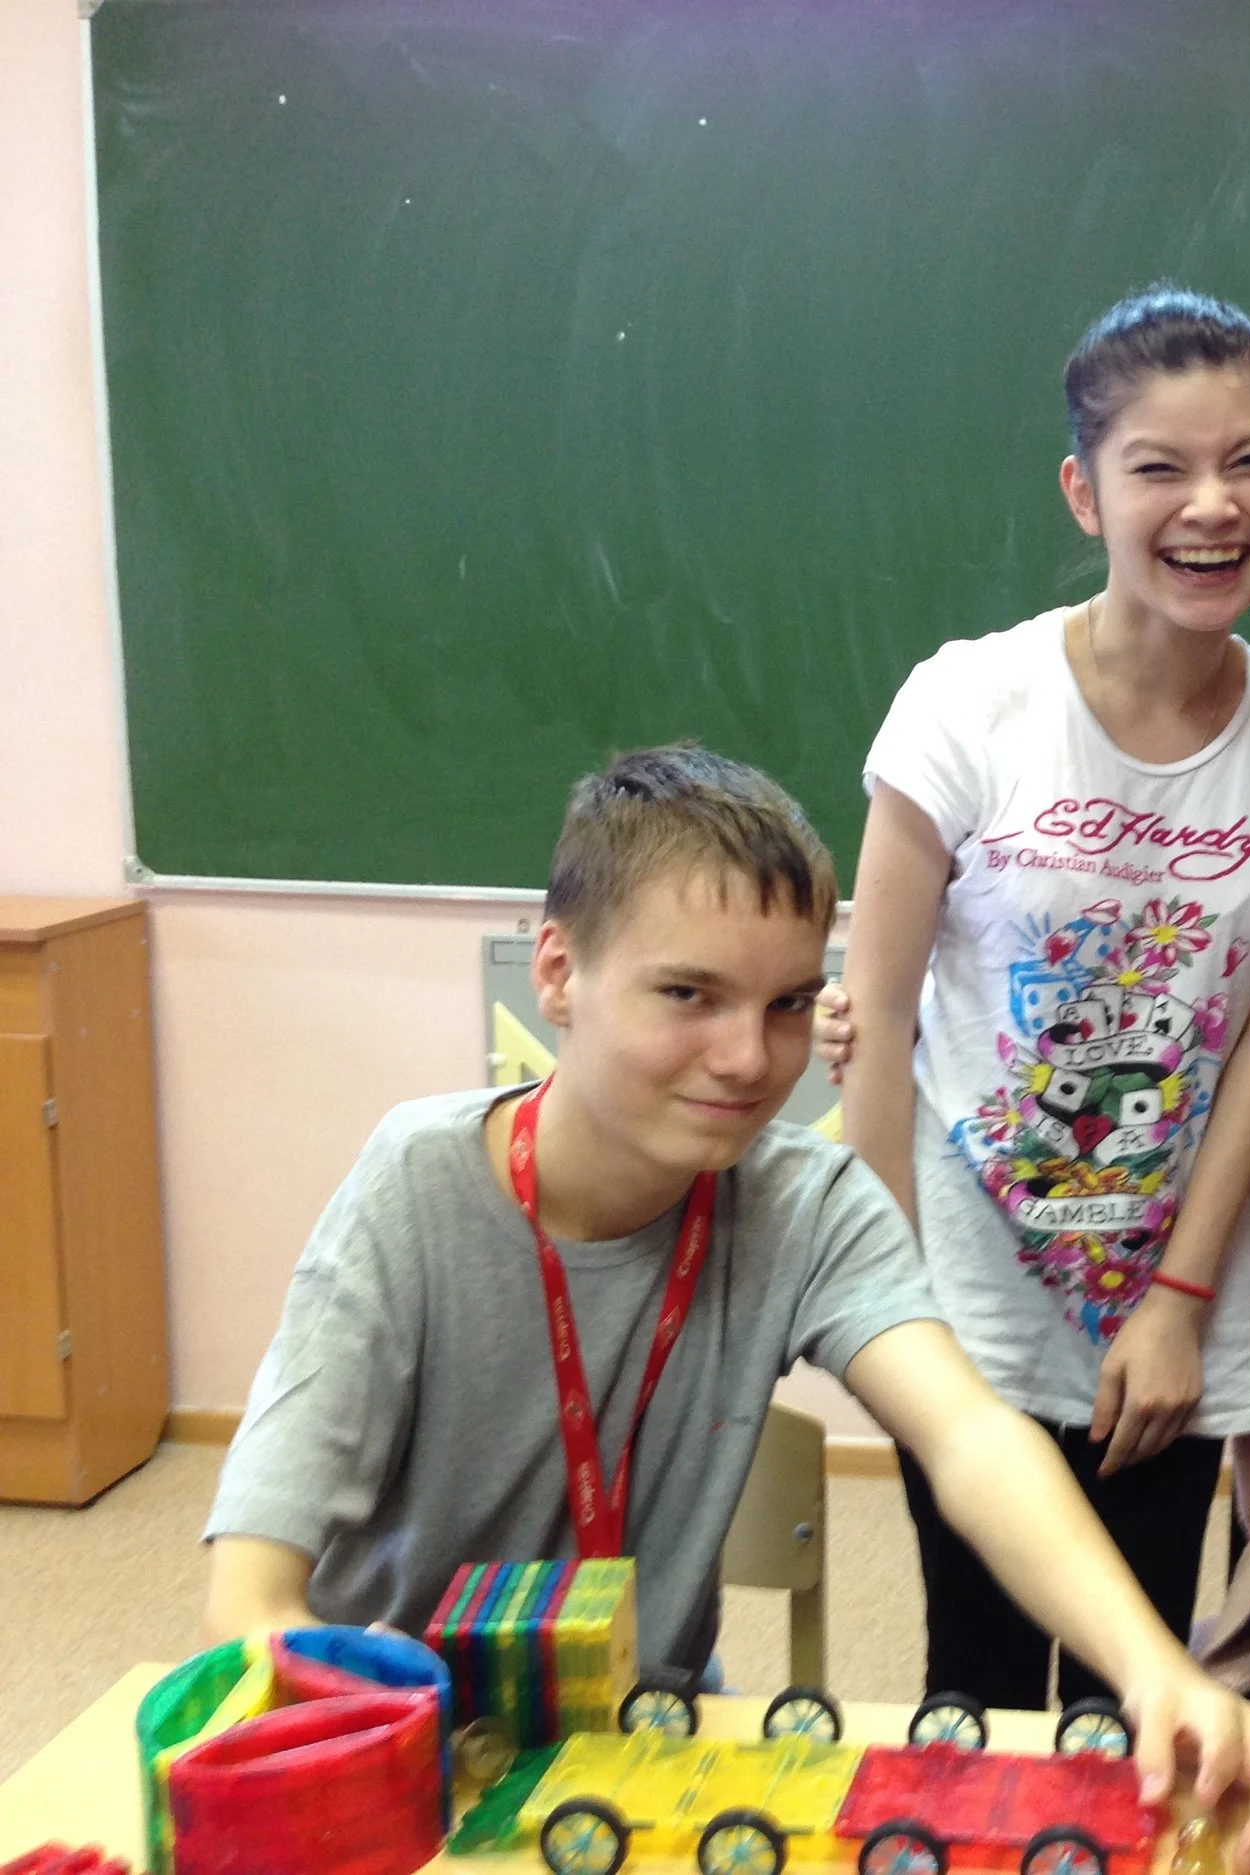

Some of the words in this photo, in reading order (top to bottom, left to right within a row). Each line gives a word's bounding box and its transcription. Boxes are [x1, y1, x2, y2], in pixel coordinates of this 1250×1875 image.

[987, 849, 1011, 873] By
[1016, 848, 1097, 874] Christian
[1065, 1033, 1154, 1066] LOVE
[1035, 1115, 1067, 1144] IS
